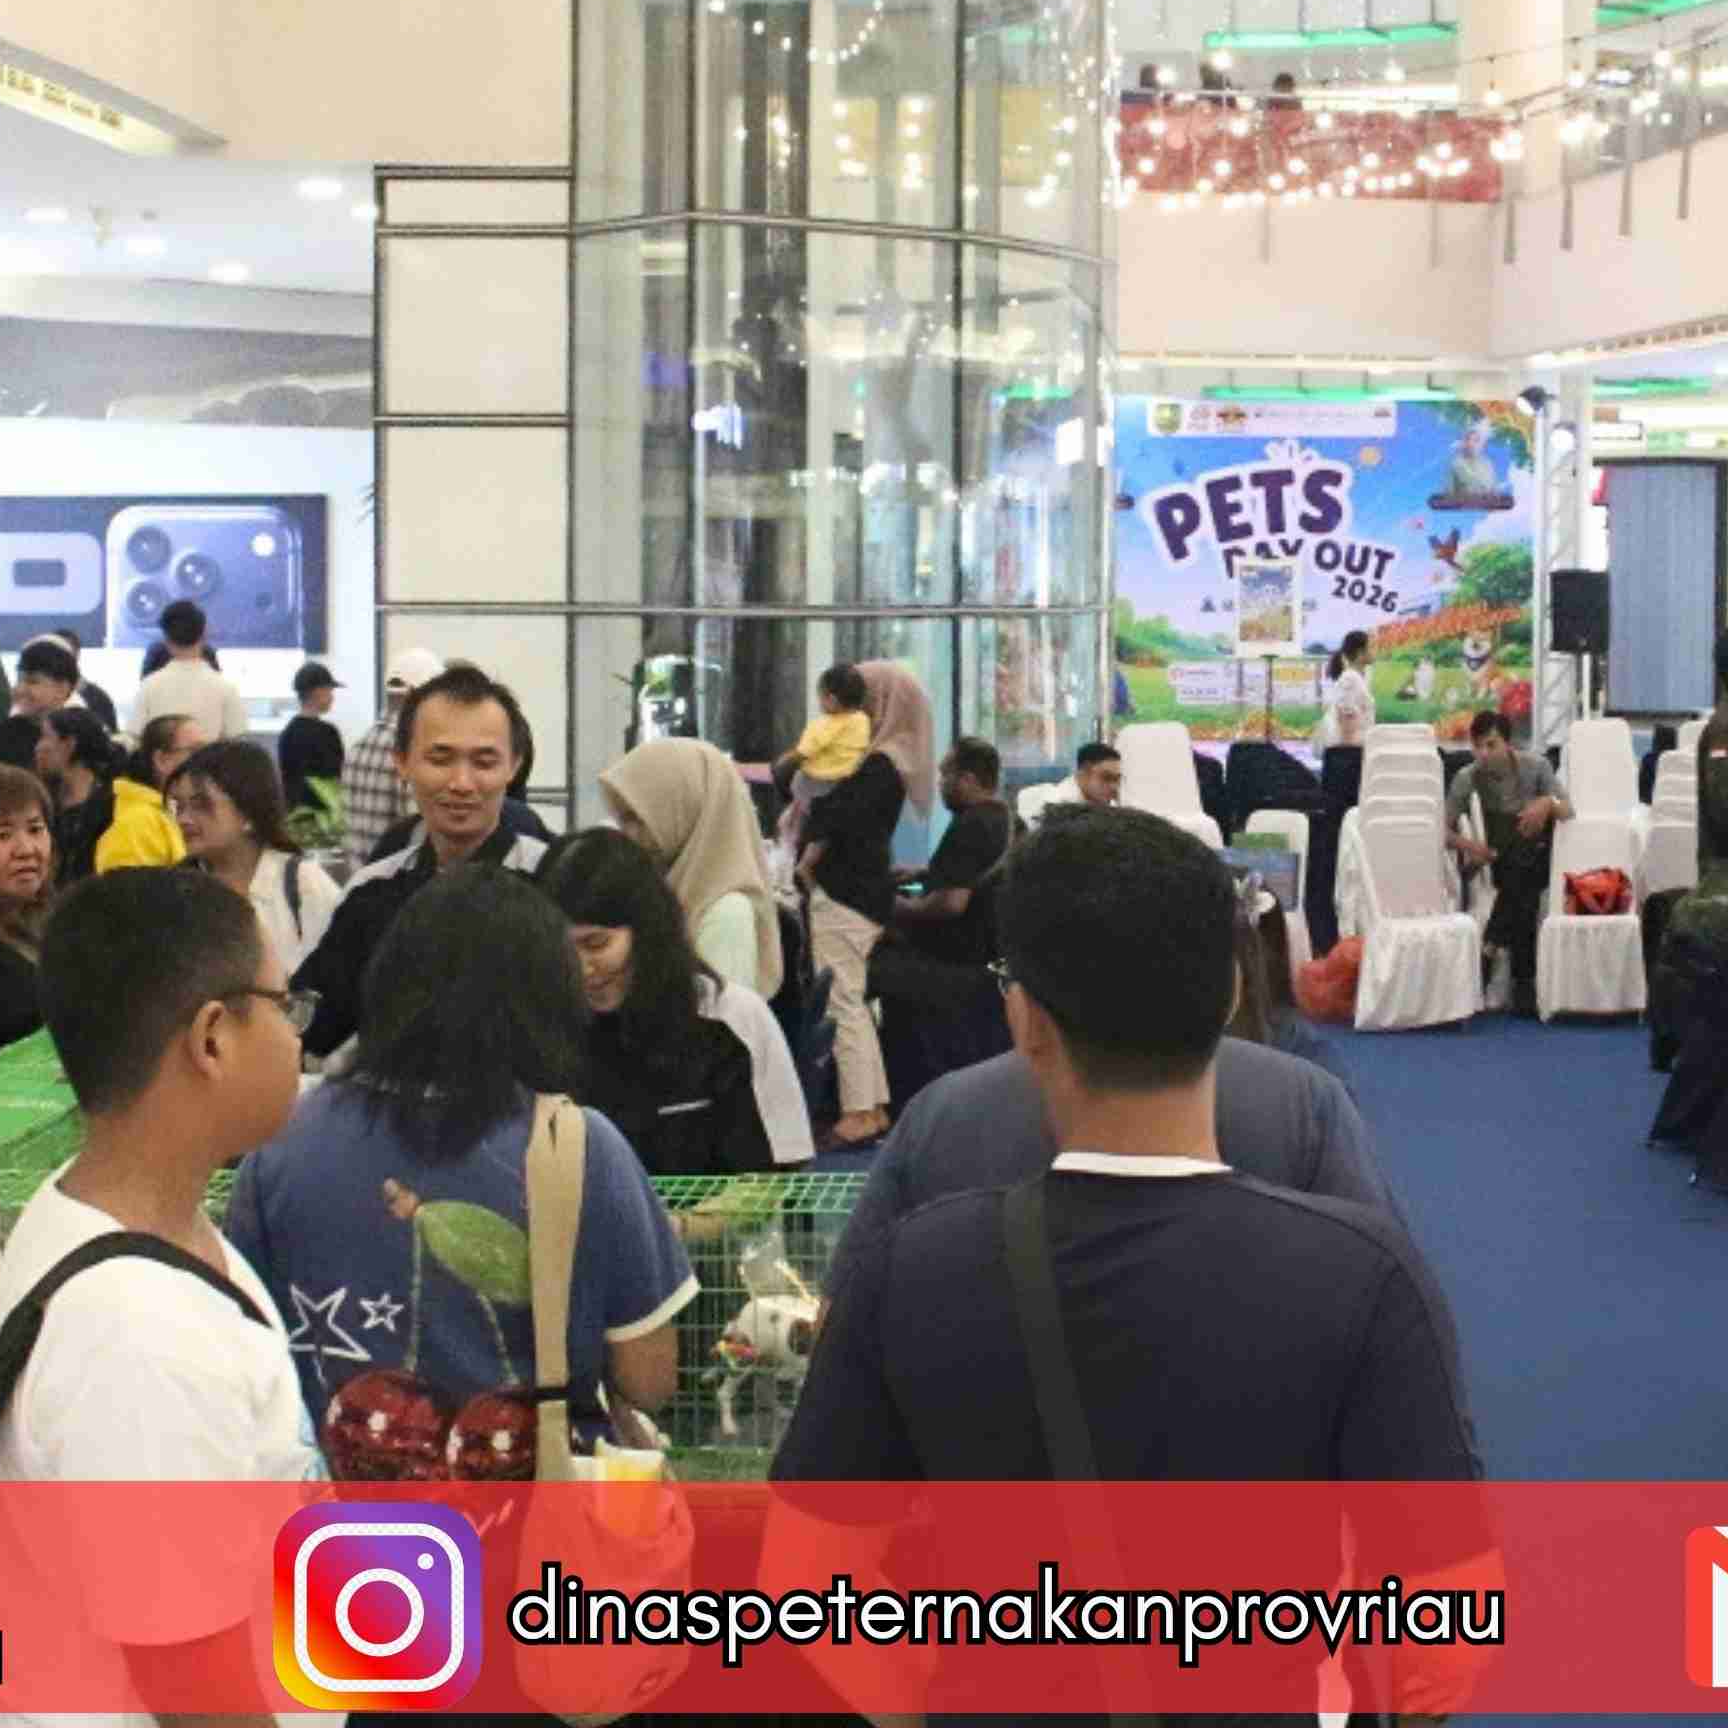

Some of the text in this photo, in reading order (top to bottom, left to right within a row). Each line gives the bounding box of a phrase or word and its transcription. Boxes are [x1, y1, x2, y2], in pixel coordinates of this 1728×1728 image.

[1153, 468, 1344, 561] PETS
[1314, 540, 1396, 580] OUT
[1330, 574, 1401, 614] 2026
